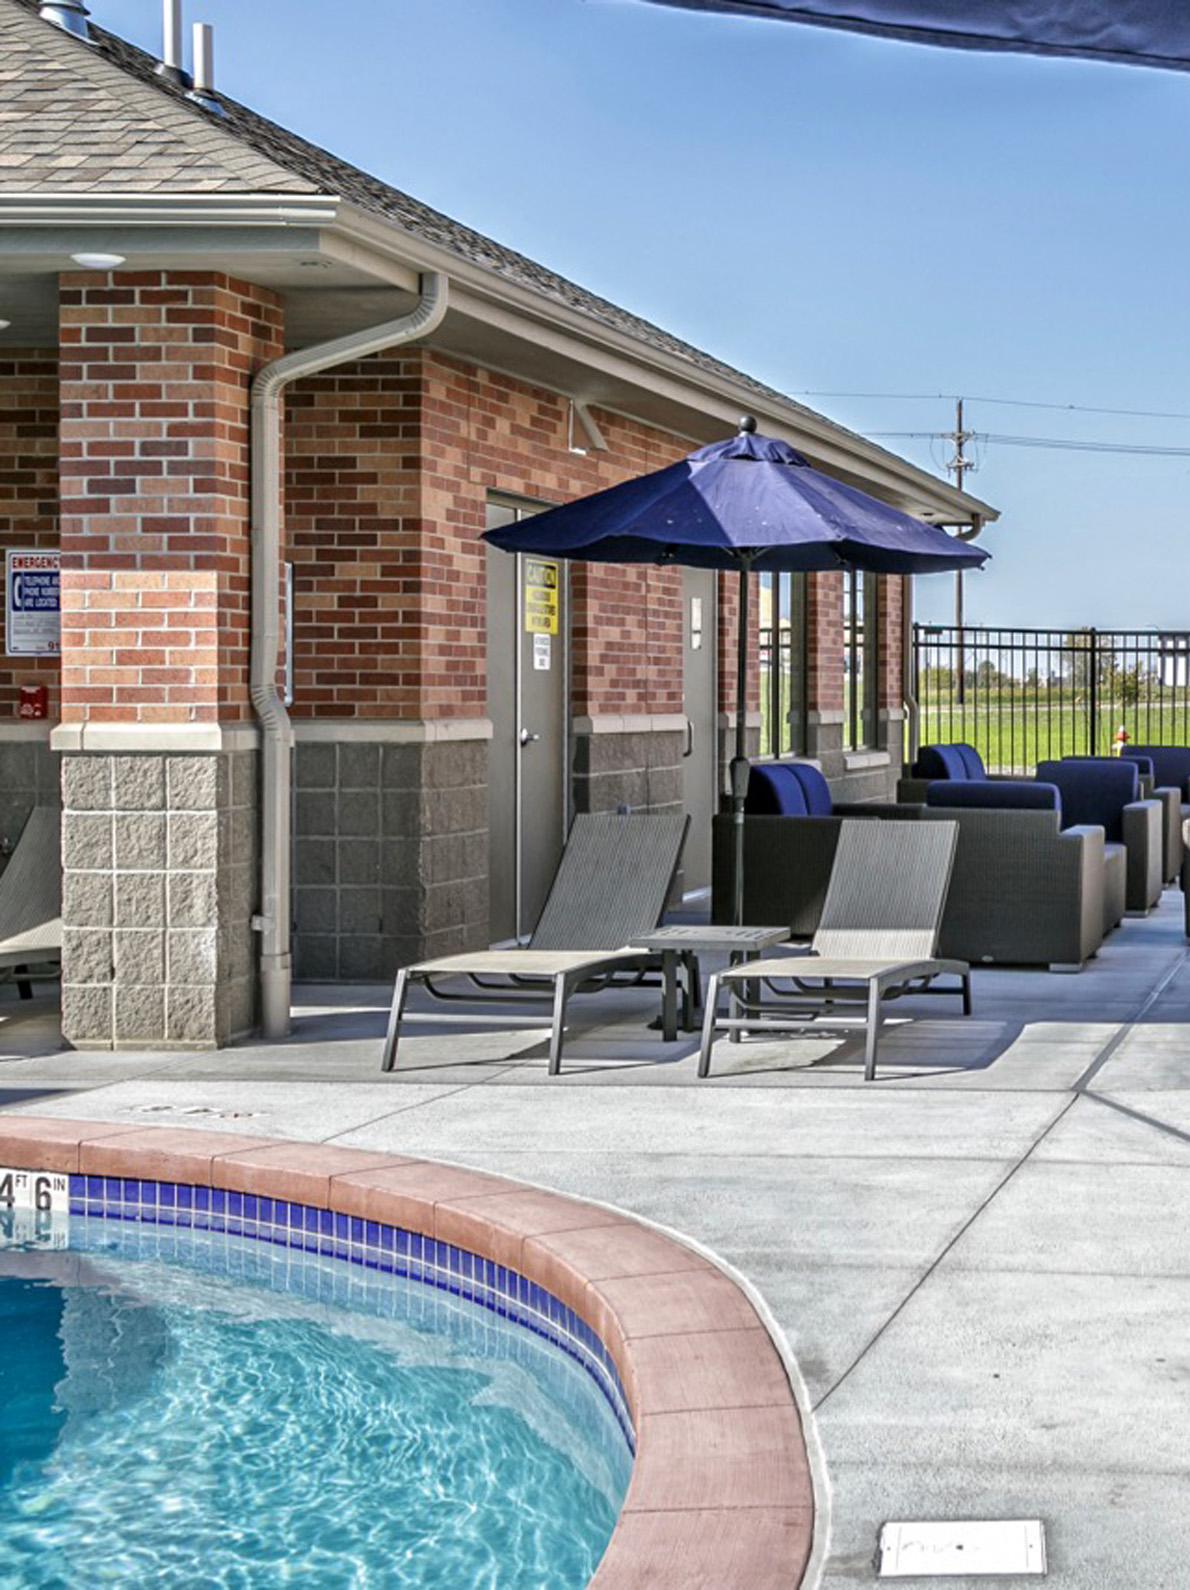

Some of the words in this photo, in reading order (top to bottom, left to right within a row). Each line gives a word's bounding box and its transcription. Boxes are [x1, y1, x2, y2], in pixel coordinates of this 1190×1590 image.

[12, 557, 60, 569] EMERGENC
[41, 587, 60, 596] NUMBER
[48, 641, 60, 652] 91
[0, 1173, 15, 1208] 4
[15, 1174, 28, 1188] FT
[35, 1176, 52, 1210] 6
[54, 1178, 66, 1191] IN
